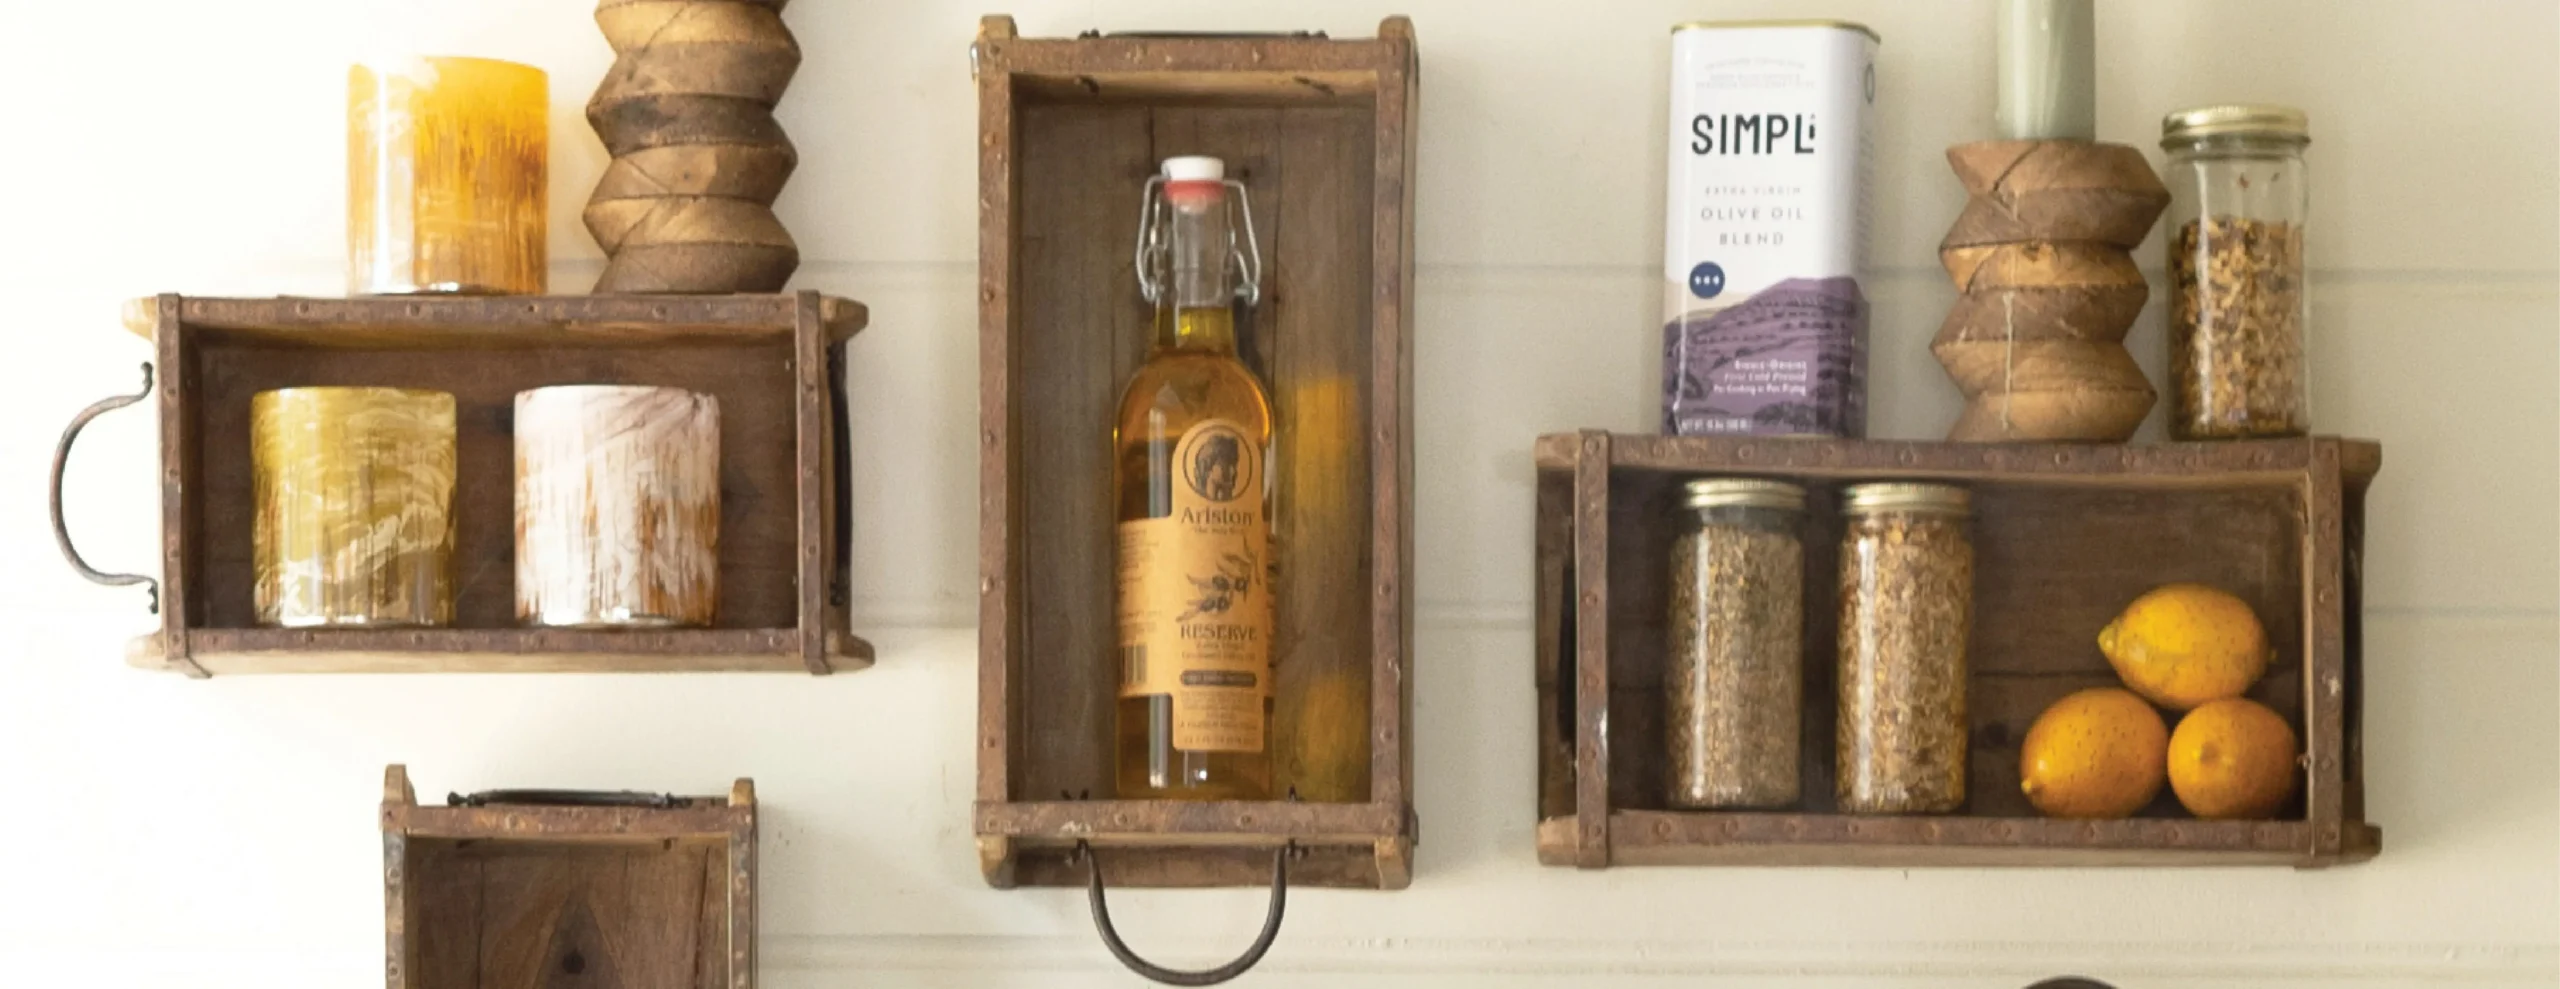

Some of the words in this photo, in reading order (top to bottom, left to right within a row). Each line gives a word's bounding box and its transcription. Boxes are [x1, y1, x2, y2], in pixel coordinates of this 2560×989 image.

[1704, 185, 1746, 196] EXTRA
[1752, 185, 1802, 196] VIRGIN
[1701, 206, 1761, 221] OLIVE
[1771, 206, 1804, 221] OIL
[1718, 231, 1785, 246] BLEND
[1180, 506, 1253, 526] Ariston
[1180, 623, 1258, 642] RESERVE
